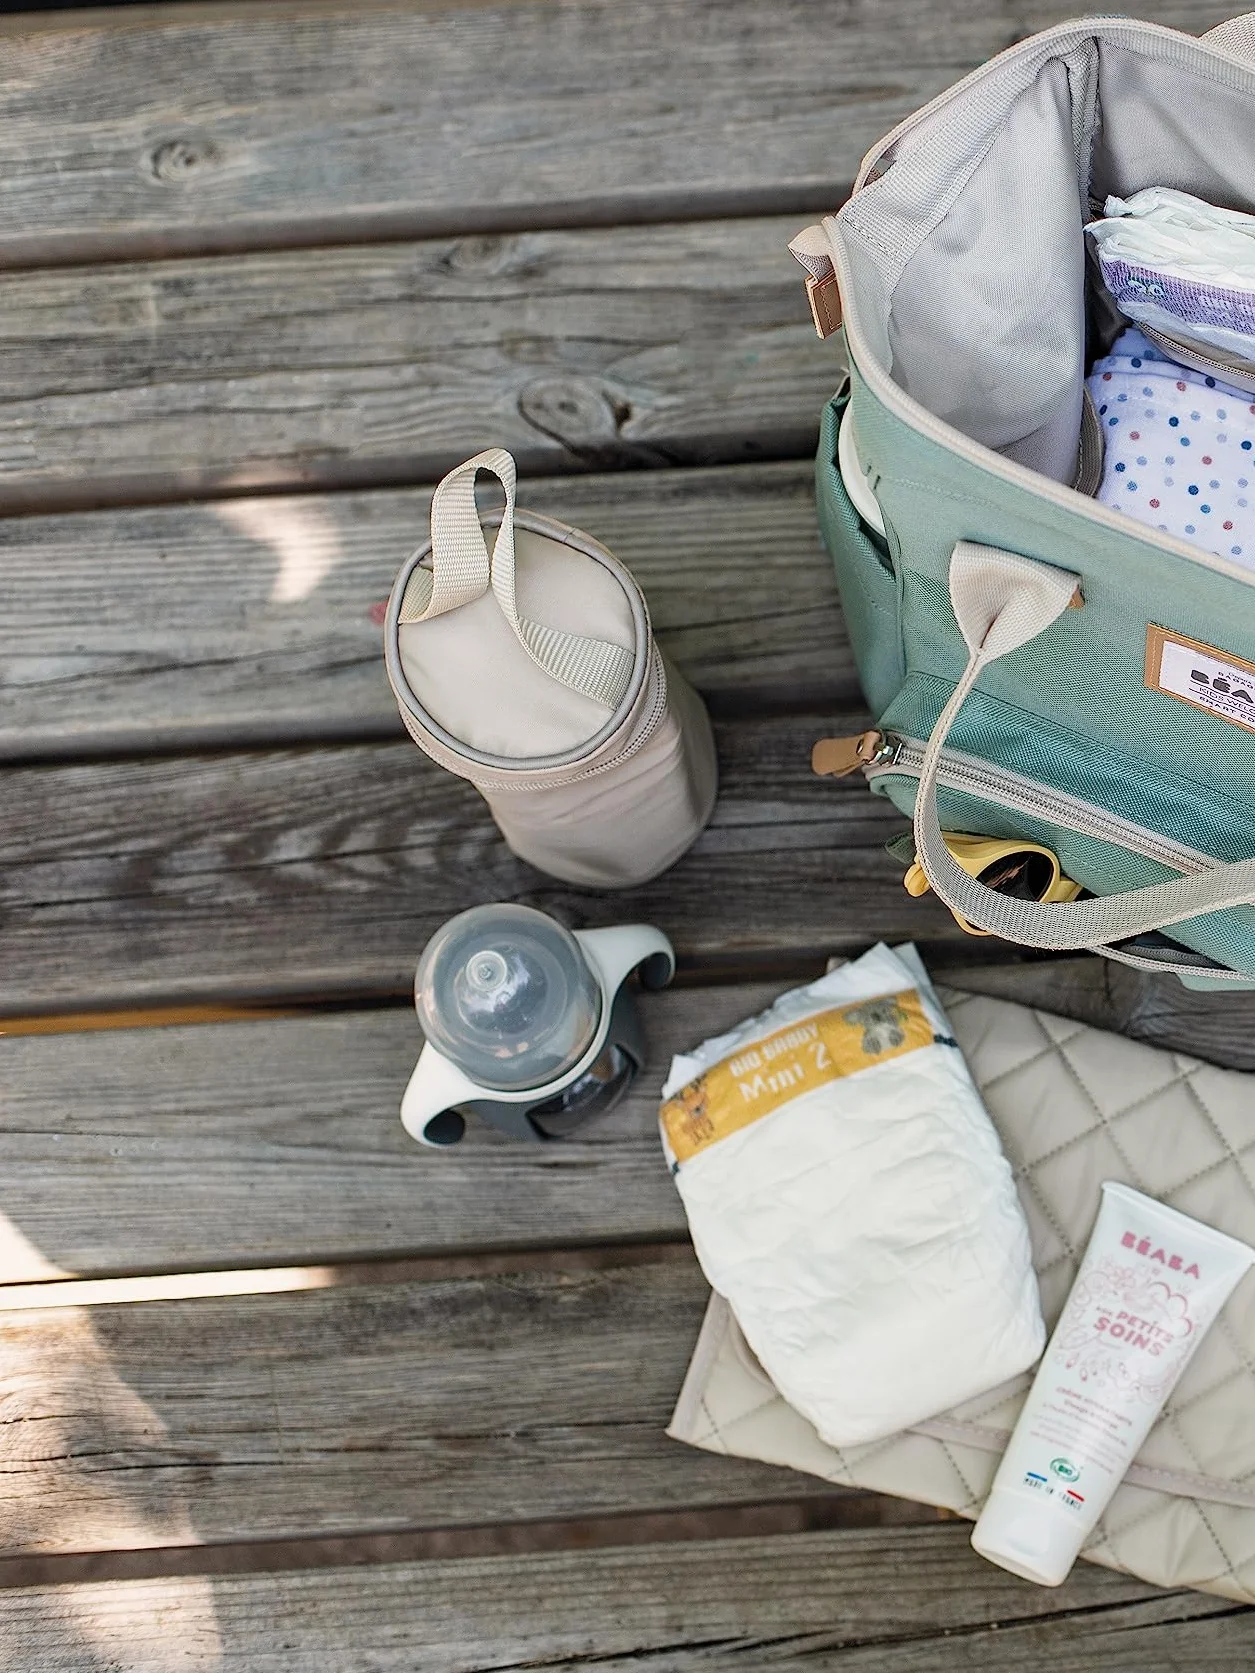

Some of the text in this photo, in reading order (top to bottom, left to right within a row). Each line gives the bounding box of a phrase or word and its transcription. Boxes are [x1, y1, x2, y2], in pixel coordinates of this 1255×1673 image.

[1199, 687, 1224, 702] KIDS
[1199, 696, 1237, 714] SMART
[807, 1041, 833, 1071] 2
[1120, 1230, 1200, 1280] BÉABA
[1093, 1316, 1166, 1357] SOINS
